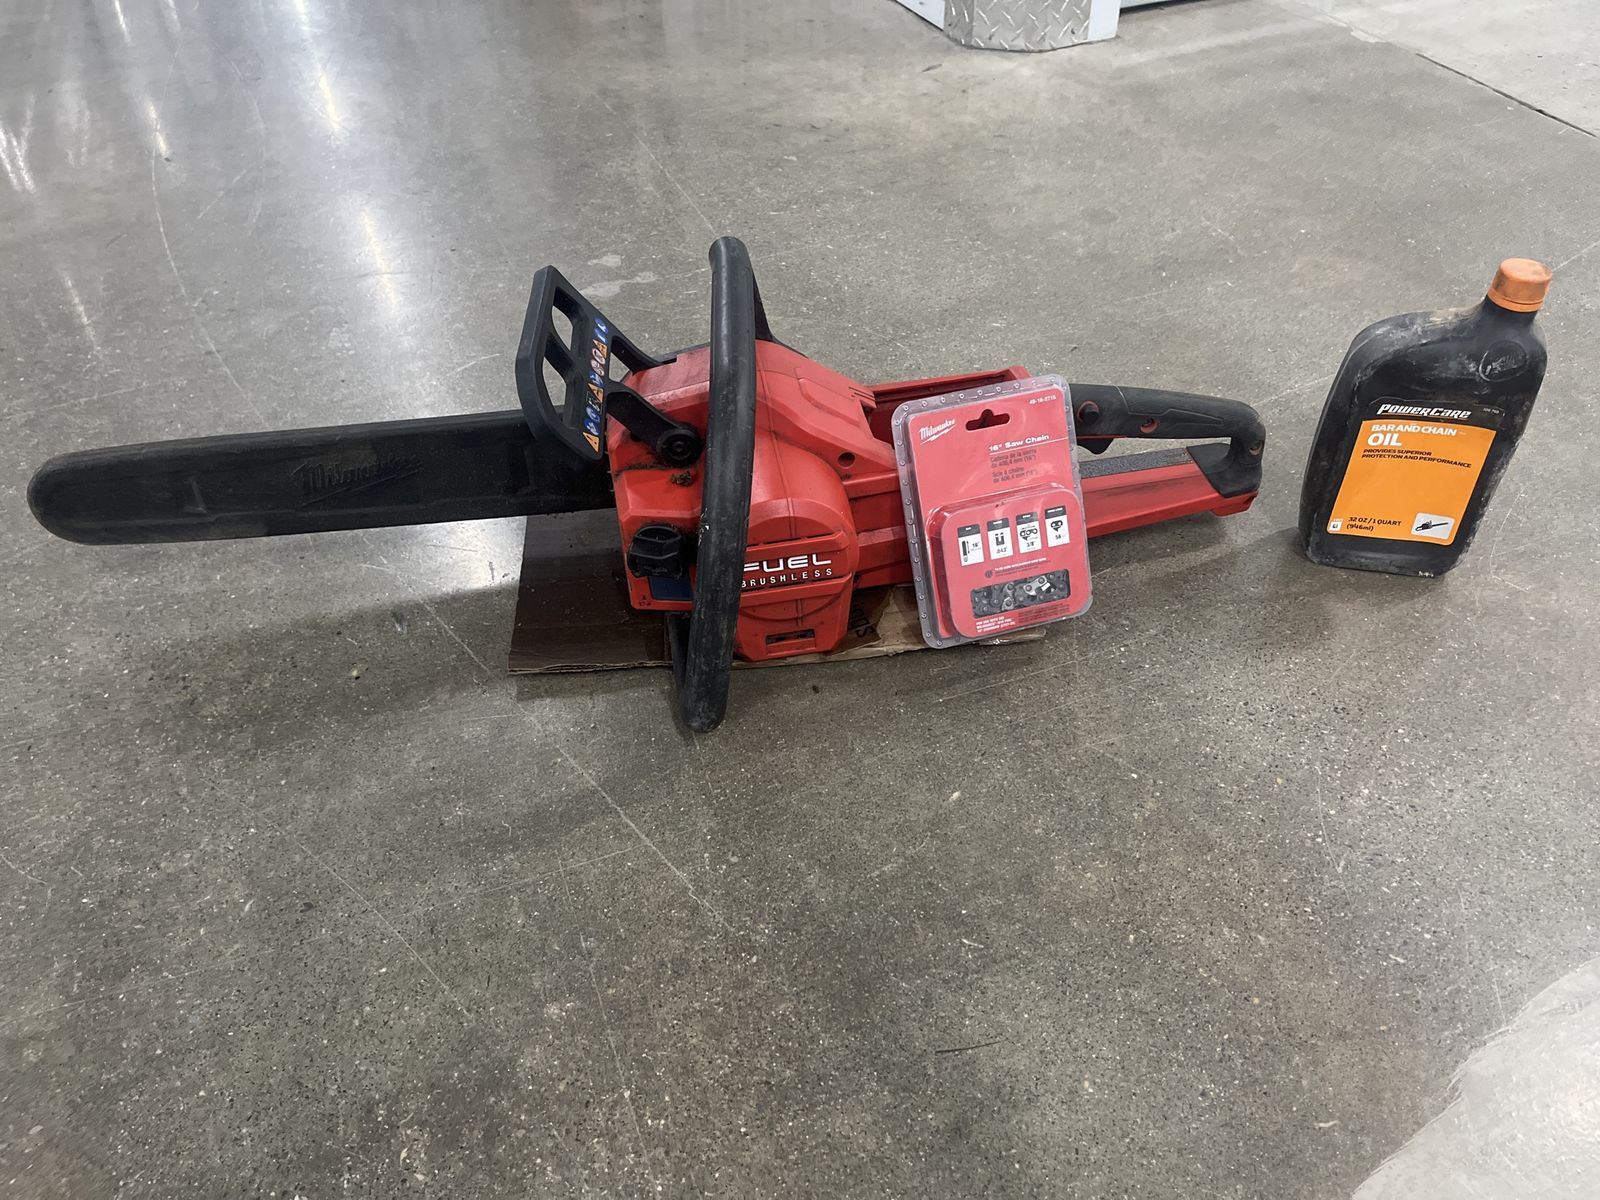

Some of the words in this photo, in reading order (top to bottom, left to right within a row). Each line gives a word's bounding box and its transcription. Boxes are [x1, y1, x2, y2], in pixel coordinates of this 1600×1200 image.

[919, 418, 956, 443] Milwaukee
[1371, 424, 1396, 432] BAR
[1394, 425, 1421, 434] AND
[1421, 427, 1457, 436] CHAIN
[1005, 439, 1024, 448] Saw
[1025, 434, 1050, 444] Chain
[1368, 433, 1402, 446] OIL
[1418, 456, 1472, 468] PERFORMANCE
[744, 553, 832, 572] FUEL
[741, 568, 832, 588] BRUSHLESS
